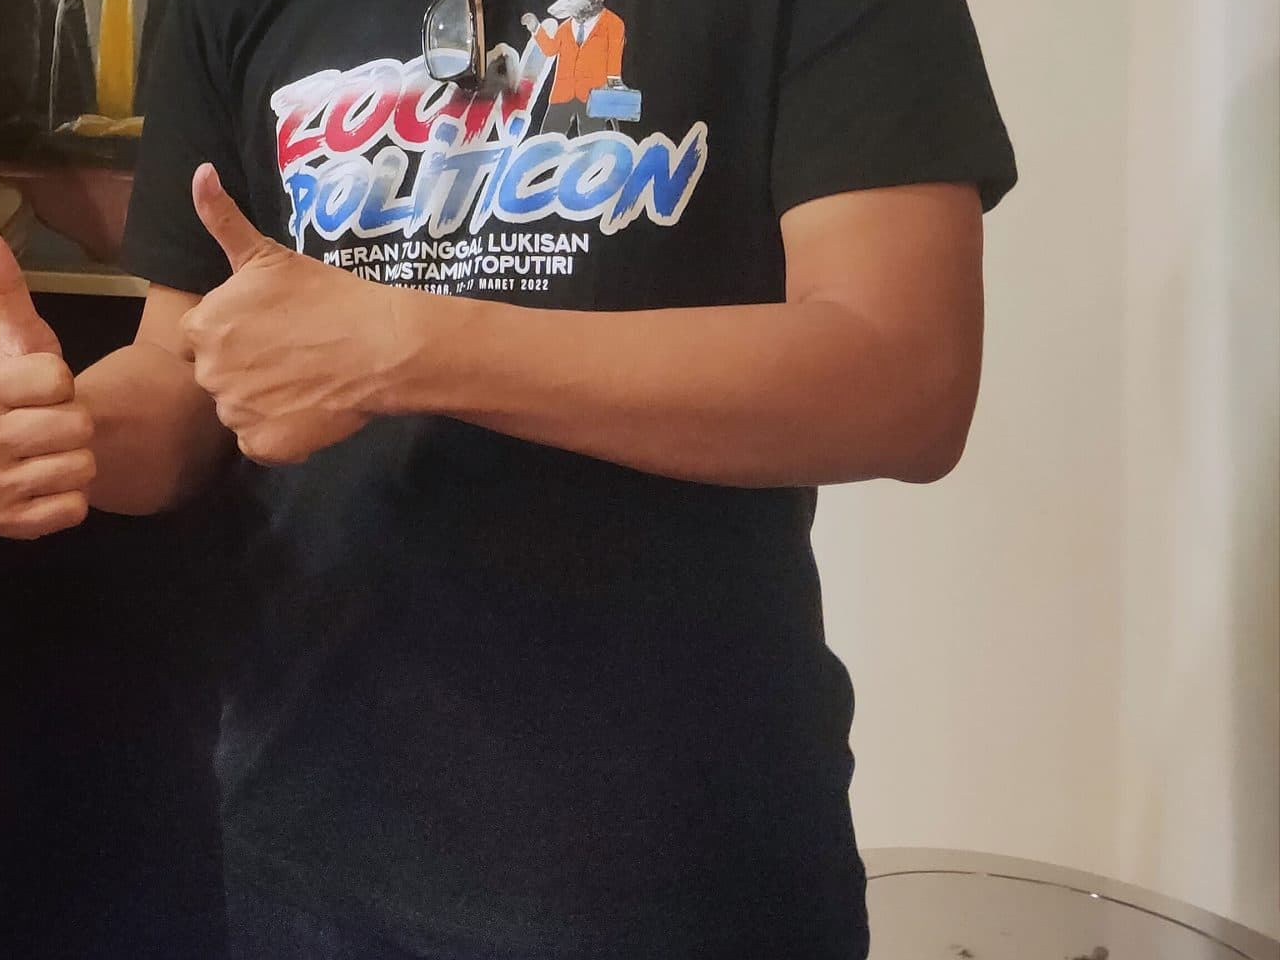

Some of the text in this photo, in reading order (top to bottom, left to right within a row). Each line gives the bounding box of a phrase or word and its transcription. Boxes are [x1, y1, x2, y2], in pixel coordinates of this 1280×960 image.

[271, 40, 556, 174] ZOON
[282, 117, 708, 253] POLITICON
[401, 237, 483, 261] TUNGGAL
[488, 232, 589, 254] LUKISAN
[474, 255, 573, 278] TOPUTIRI
[478, 278, 515, 290] MARET
[520, 278, 549, 291] 2022
